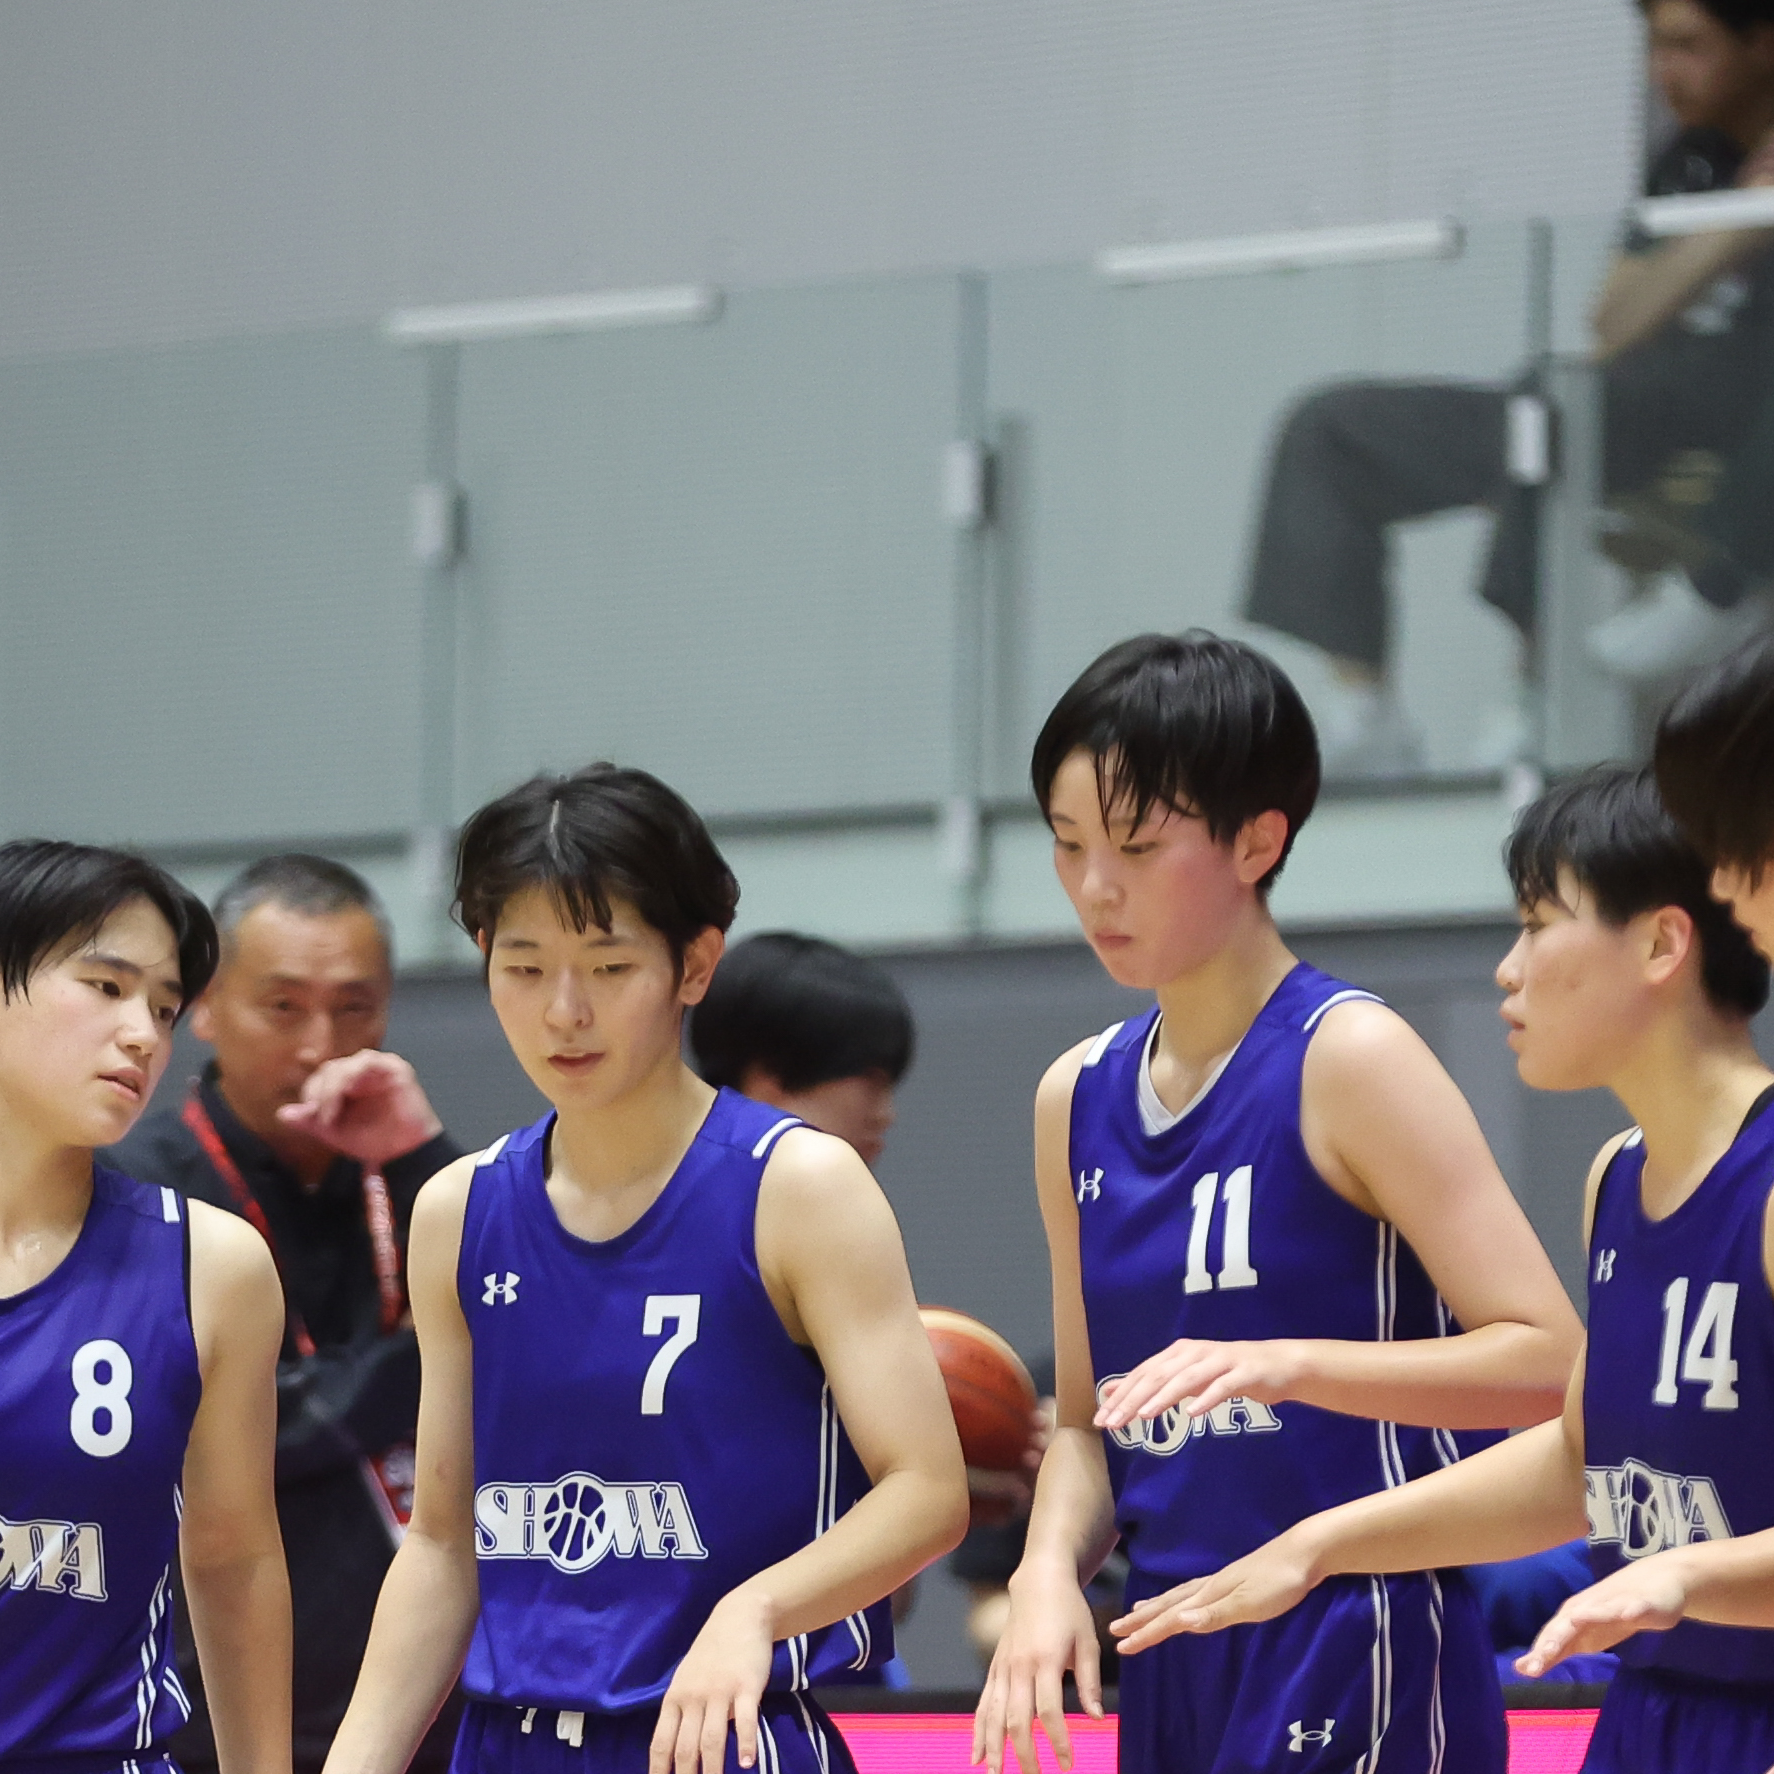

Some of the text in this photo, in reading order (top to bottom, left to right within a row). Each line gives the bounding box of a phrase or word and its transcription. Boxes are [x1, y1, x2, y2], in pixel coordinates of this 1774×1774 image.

[1182, 1163, 1259, 1295] 11
[69, 1338, 134, 1458] 8
[640, 1293, 702, 1416] 7
[1652, 1275, 1740, 1410] 14
[474, 1470, 710, 1575] SHOWA
